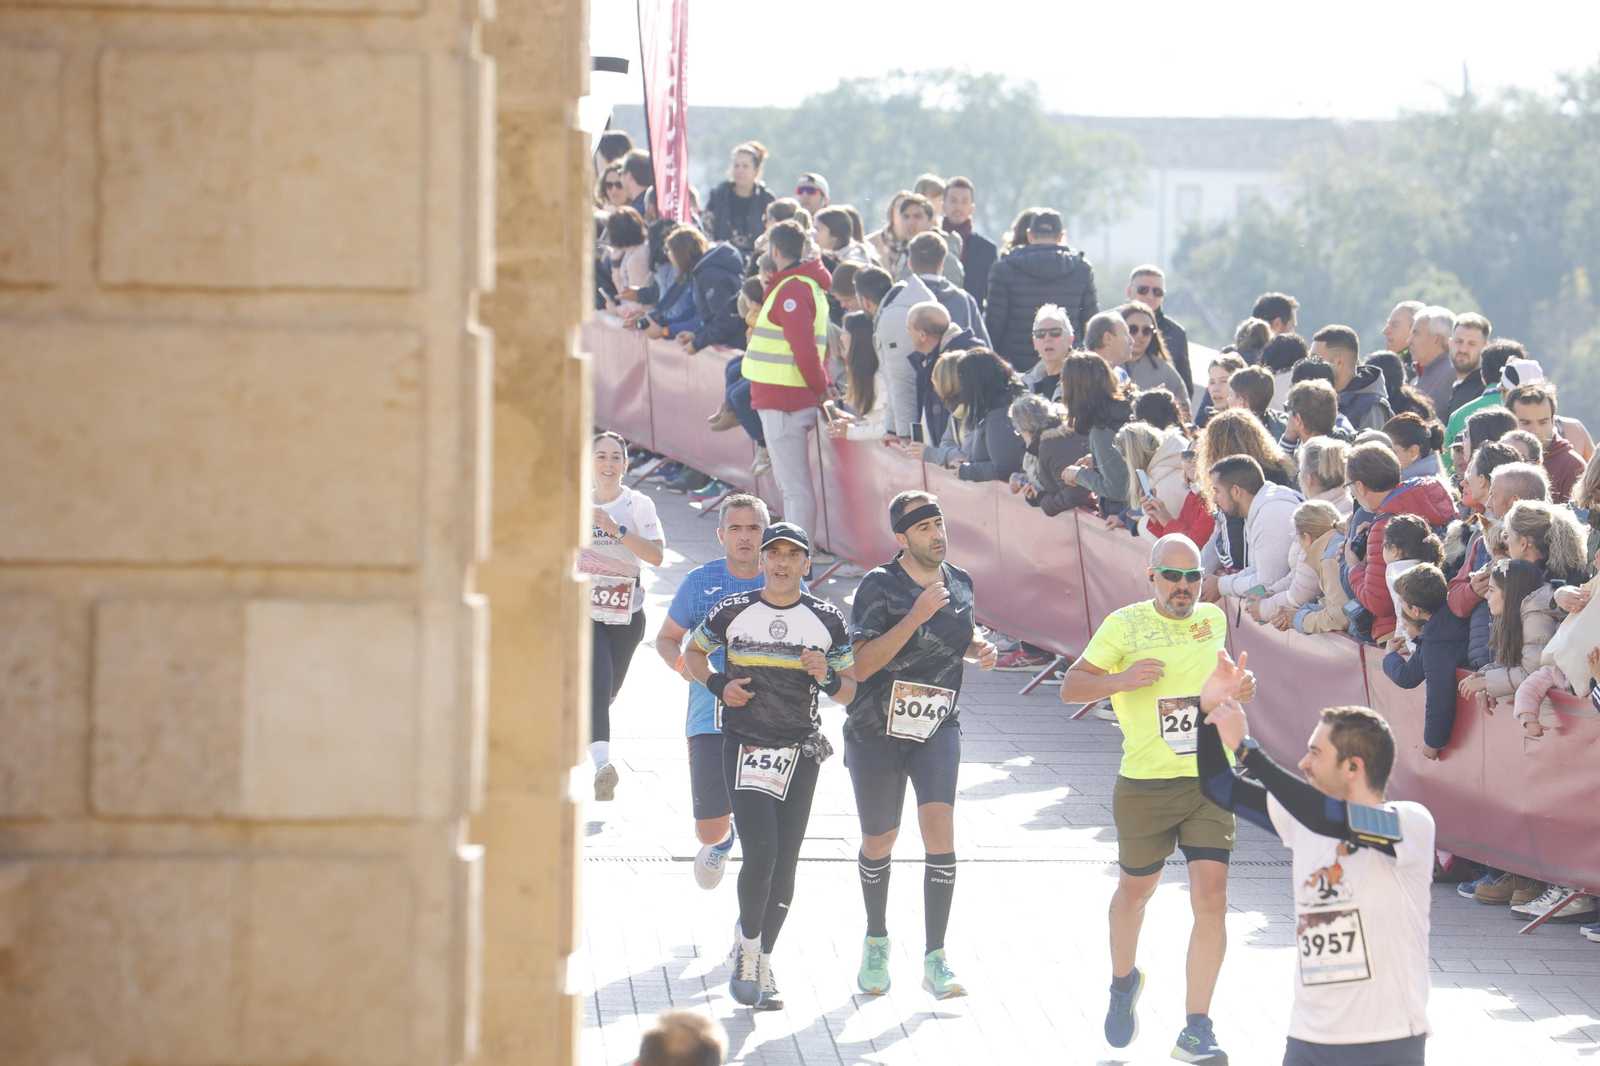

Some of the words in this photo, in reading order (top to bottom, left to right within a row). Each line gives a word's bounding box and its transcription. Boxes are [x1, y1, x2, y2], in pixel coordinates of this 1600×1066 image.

[894, 698, 948, 720] 3040
[743, 754, 792, 776] 4547
[1301, 931, 1356, 957] 3957
